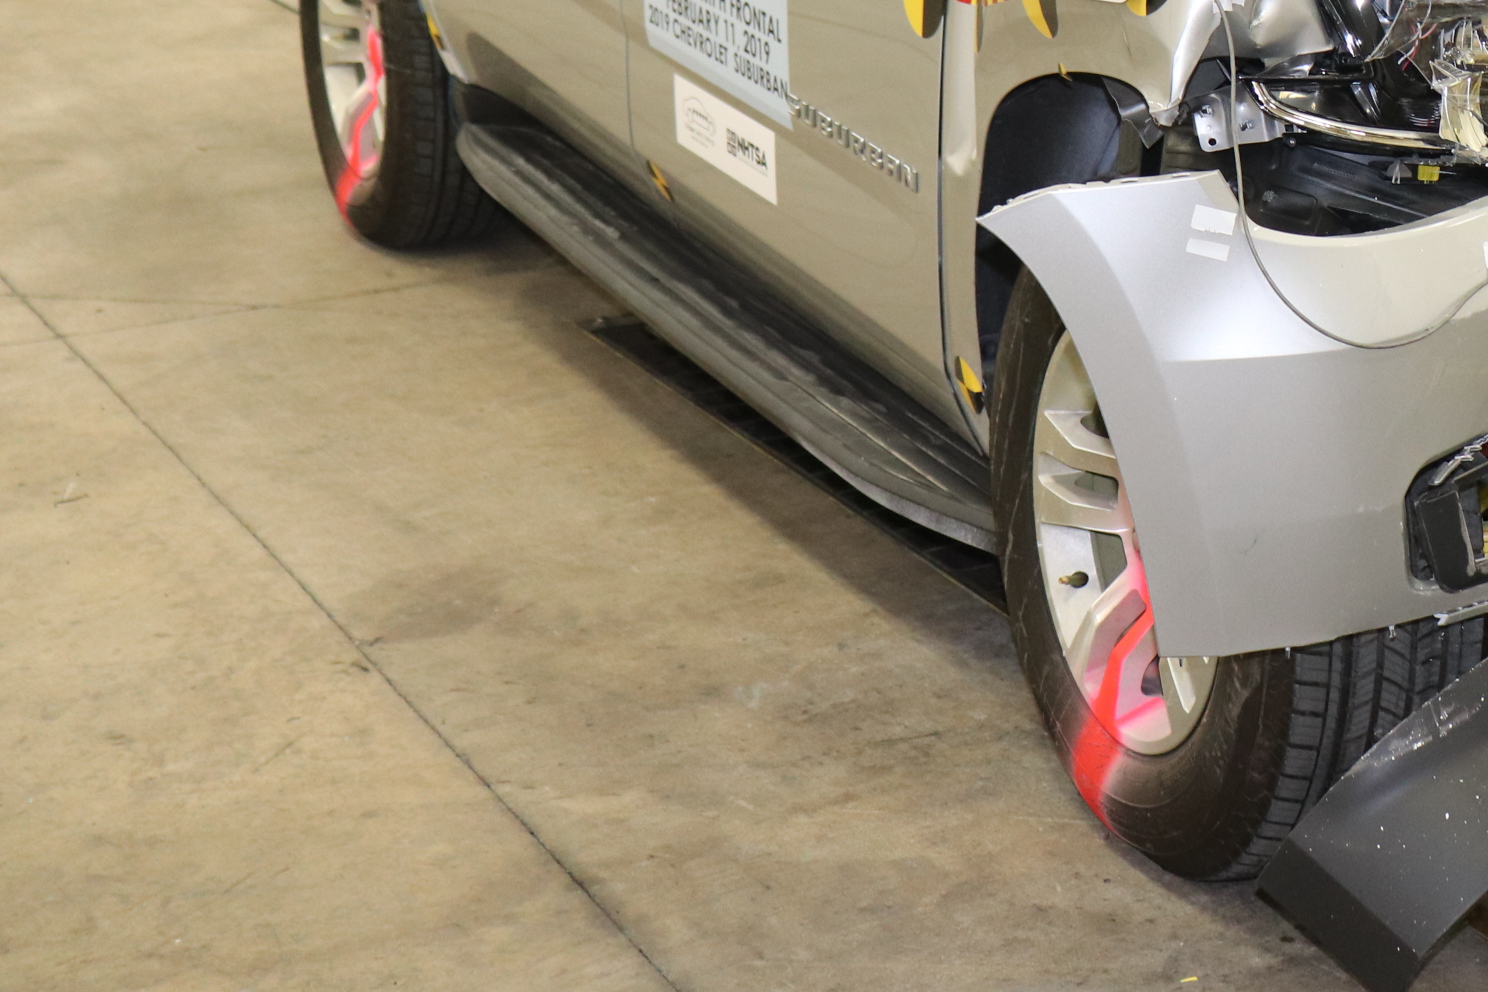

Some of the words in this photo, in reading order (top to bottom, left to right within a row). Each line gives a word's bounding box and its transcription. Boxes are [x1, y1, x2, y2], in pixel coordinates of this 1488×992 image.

[649, 4, 670, 32] 2019
[672, 18, 728, 67] CHEVROLET
[733, 52, 789, 102] SUBURBAN
[743, 30, 771, 65] 2019
[736, 136, 768, 170] NHTSA
[787, 92, 920, 194] SUBURBAN
